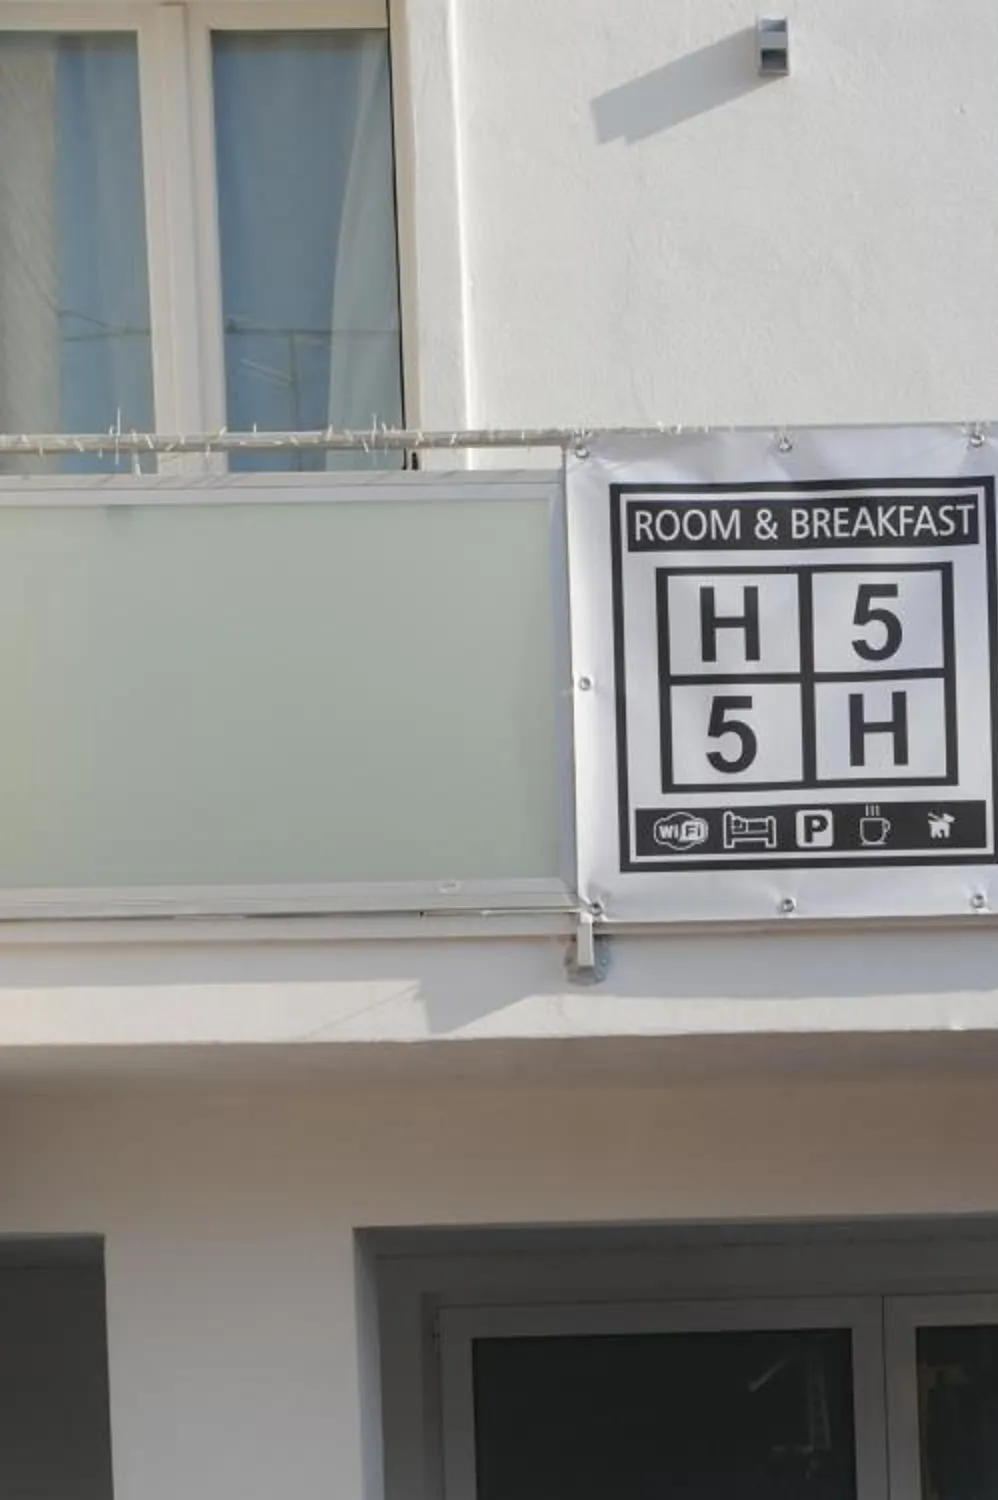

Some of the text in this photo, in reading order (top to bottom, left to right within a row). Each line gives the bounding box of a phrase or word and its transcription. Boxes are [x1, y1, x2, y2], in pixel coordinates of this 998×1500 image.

[634, 503, 976, 543] ROOM & BREAKFAST
[700, 583, 903, 662] H 5
[705, 691, 909, 774] 5 H
